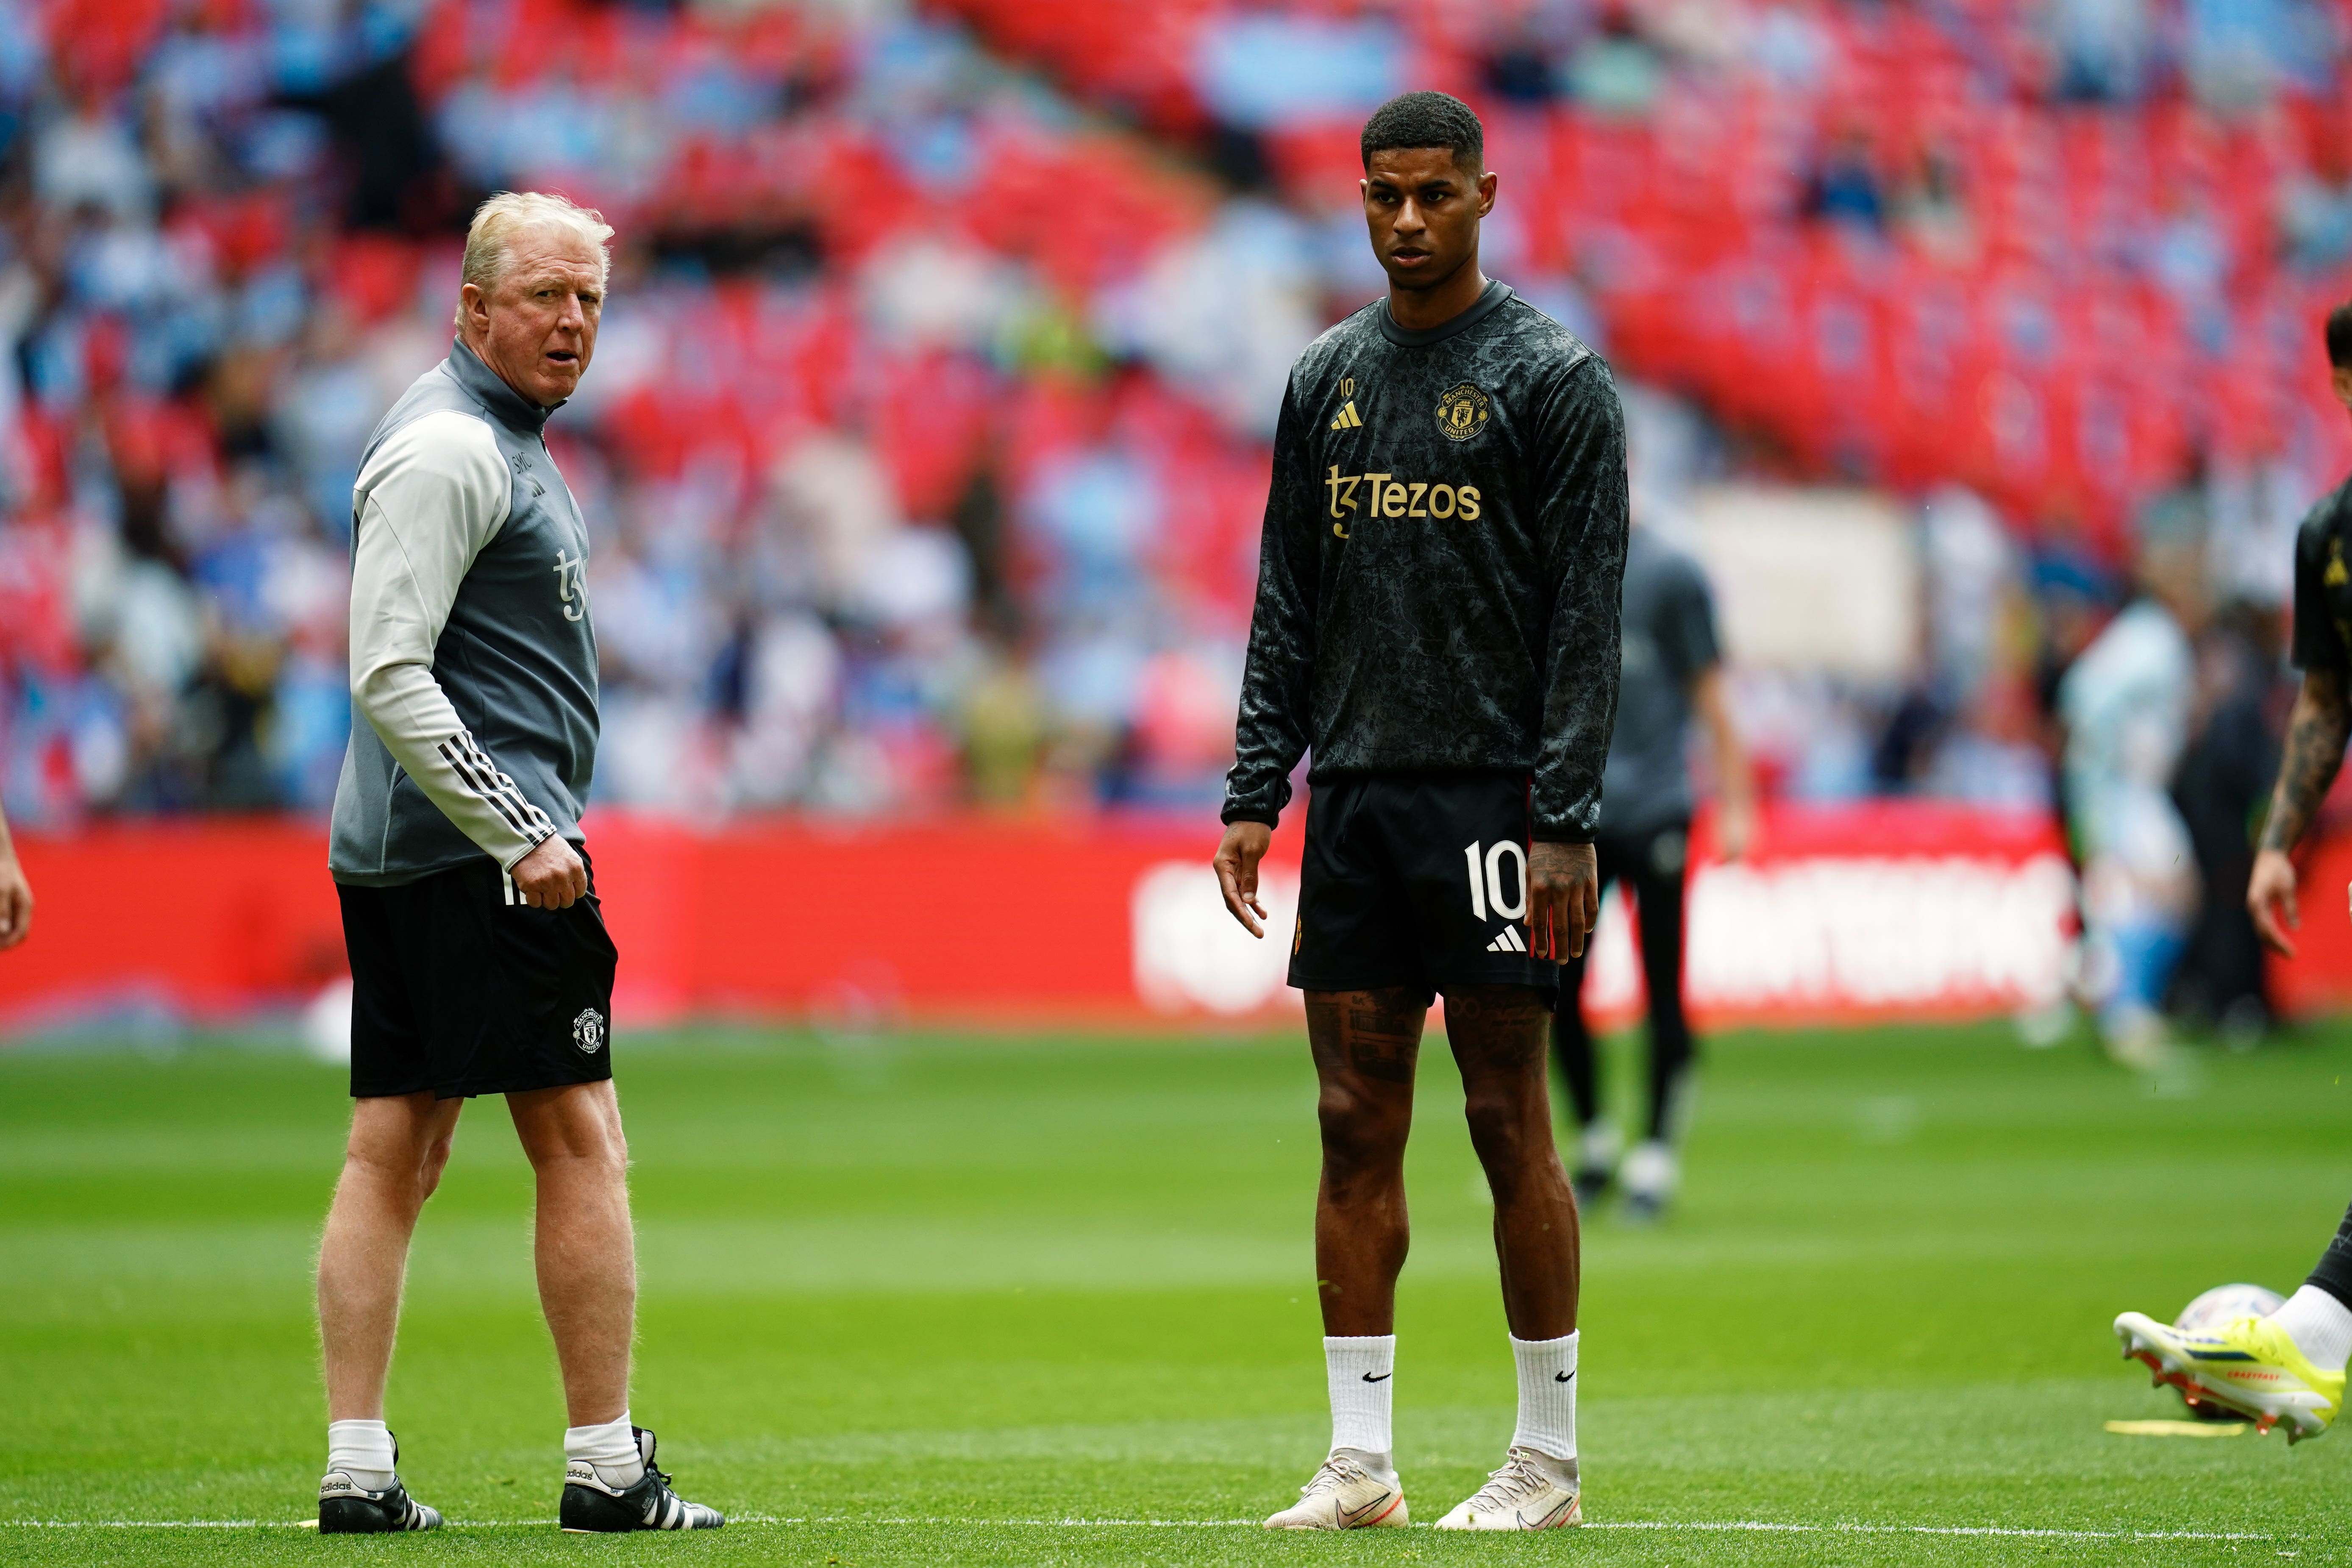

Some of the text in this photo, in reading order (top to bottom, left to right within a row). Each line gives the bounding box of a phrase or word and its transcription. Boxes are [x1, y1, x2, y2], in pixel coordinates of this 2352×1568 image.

[1340, 378, 1354, 397] 10
[1446, 389, 1485, 408] MANCHESTER
[1445, 425, 1474, 435] UNITED
[512, 451, 532, 474] SMC
[1363, 473, 1481, 520] Tezos
[1465, 840, 1526, 922] 10
[577, 1011, 602, 1027] MANCHESTER
[582, 1041, 599, 1050] UNITED
[567, 1469, 593, 1480] adidas
[321, 1482, 351, 1493] adidas
